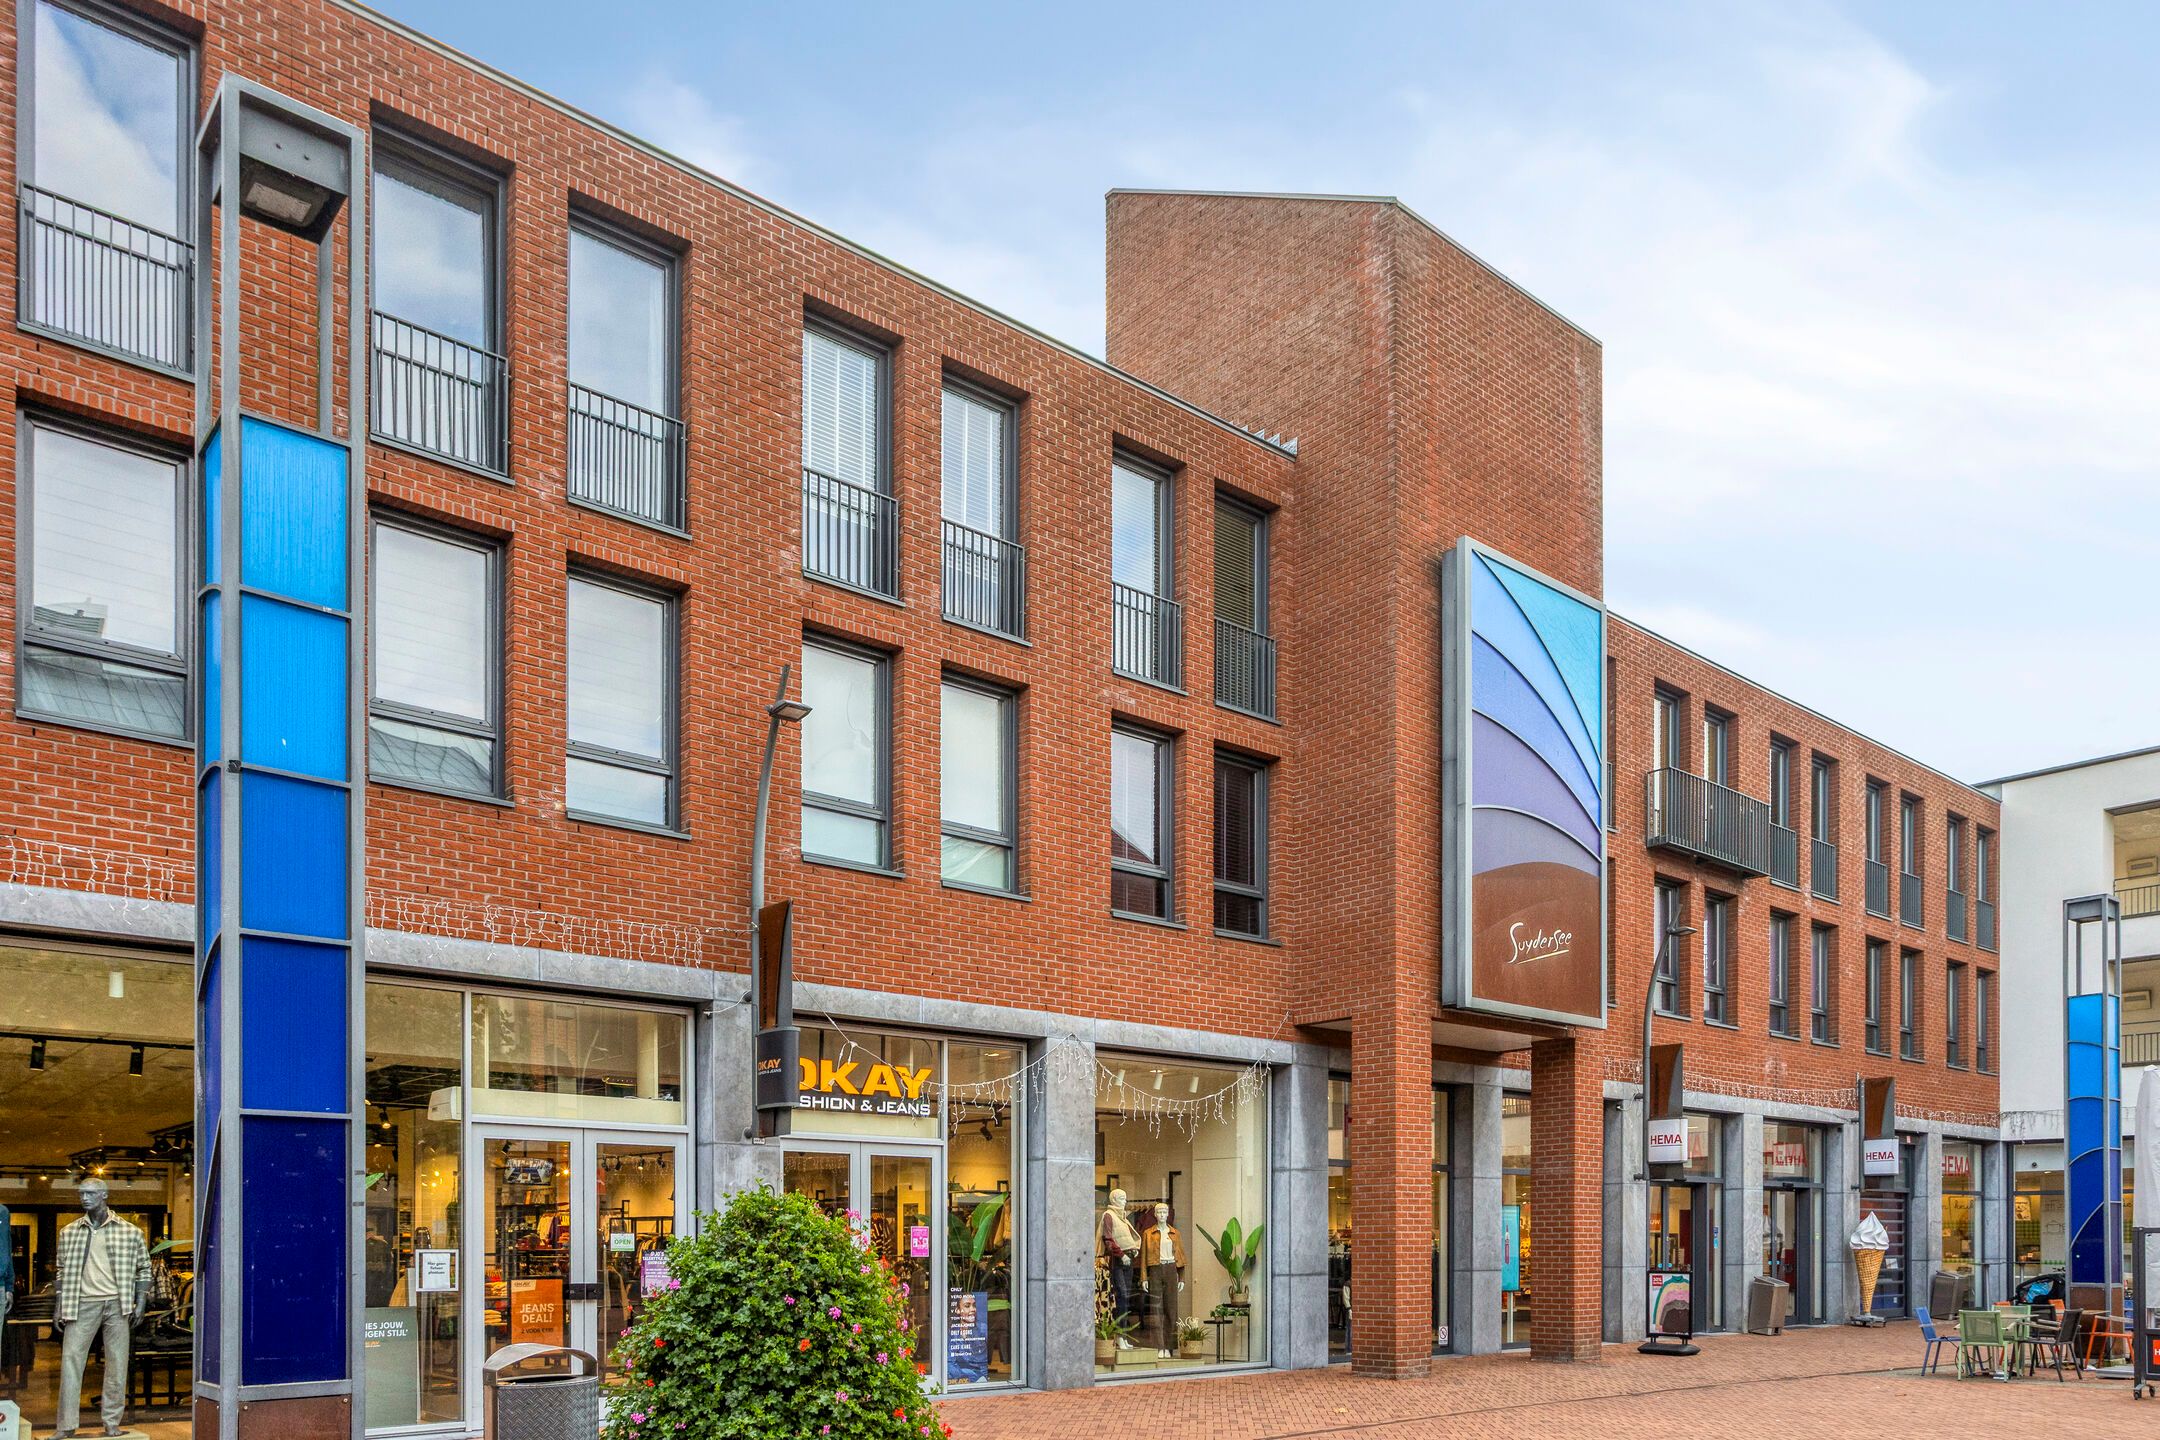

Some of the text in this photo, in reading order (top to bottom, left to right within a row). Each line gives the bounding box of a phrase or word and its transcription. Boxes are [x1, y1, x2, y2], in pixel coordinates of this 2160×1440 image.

[757, 1058, 782, 1072] OKAY
[799, 1057, 932, 1099] OKAY
[860, 1100, 873, 1112] &
[876, 1101, 931, 1116] JEANS
[1650, 1134, 1682, 1145] HEMA
[1865, 1151, 1895, 1161] HEMA
[520, 1303, 555, 1313] JEANS
[521, 1313, 553, 1324] DEAL!
[379, 1321, 404, 1329] JOUW
